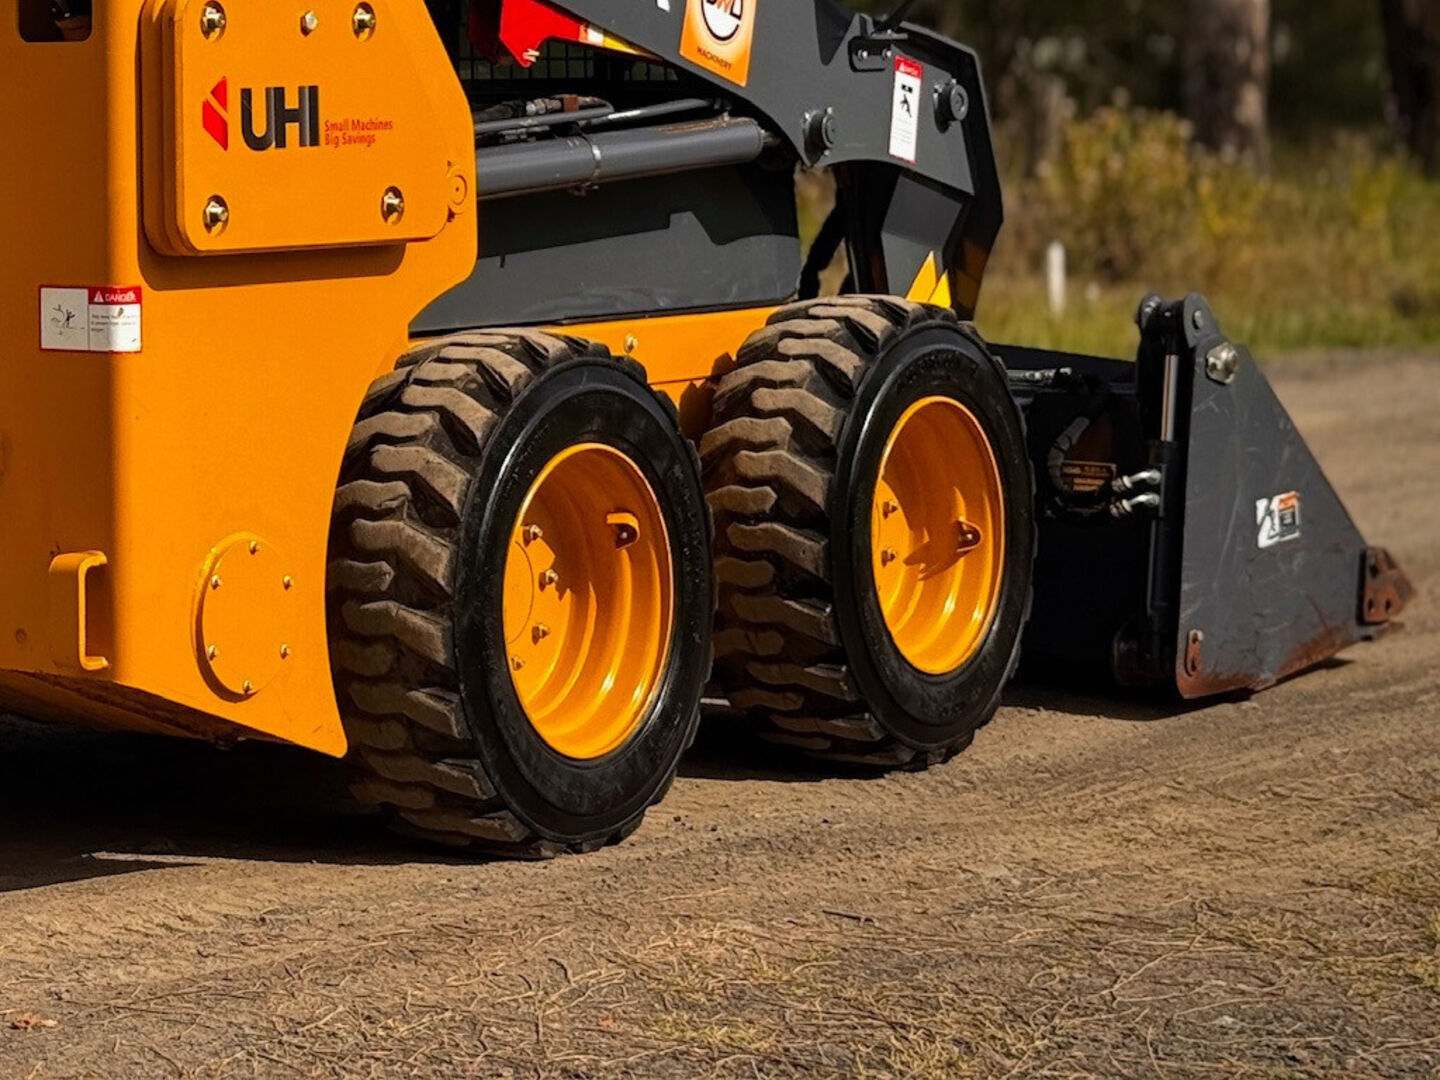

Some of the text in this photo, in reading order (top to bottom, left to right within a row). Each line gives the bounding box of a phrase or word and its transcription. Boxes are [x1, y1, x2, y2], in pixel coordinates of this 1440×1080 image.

[240, 85, 319, 152] UHI
[324, 117, 393, 132] Small Machines
[324, 132, 376, 148] Big Savings
